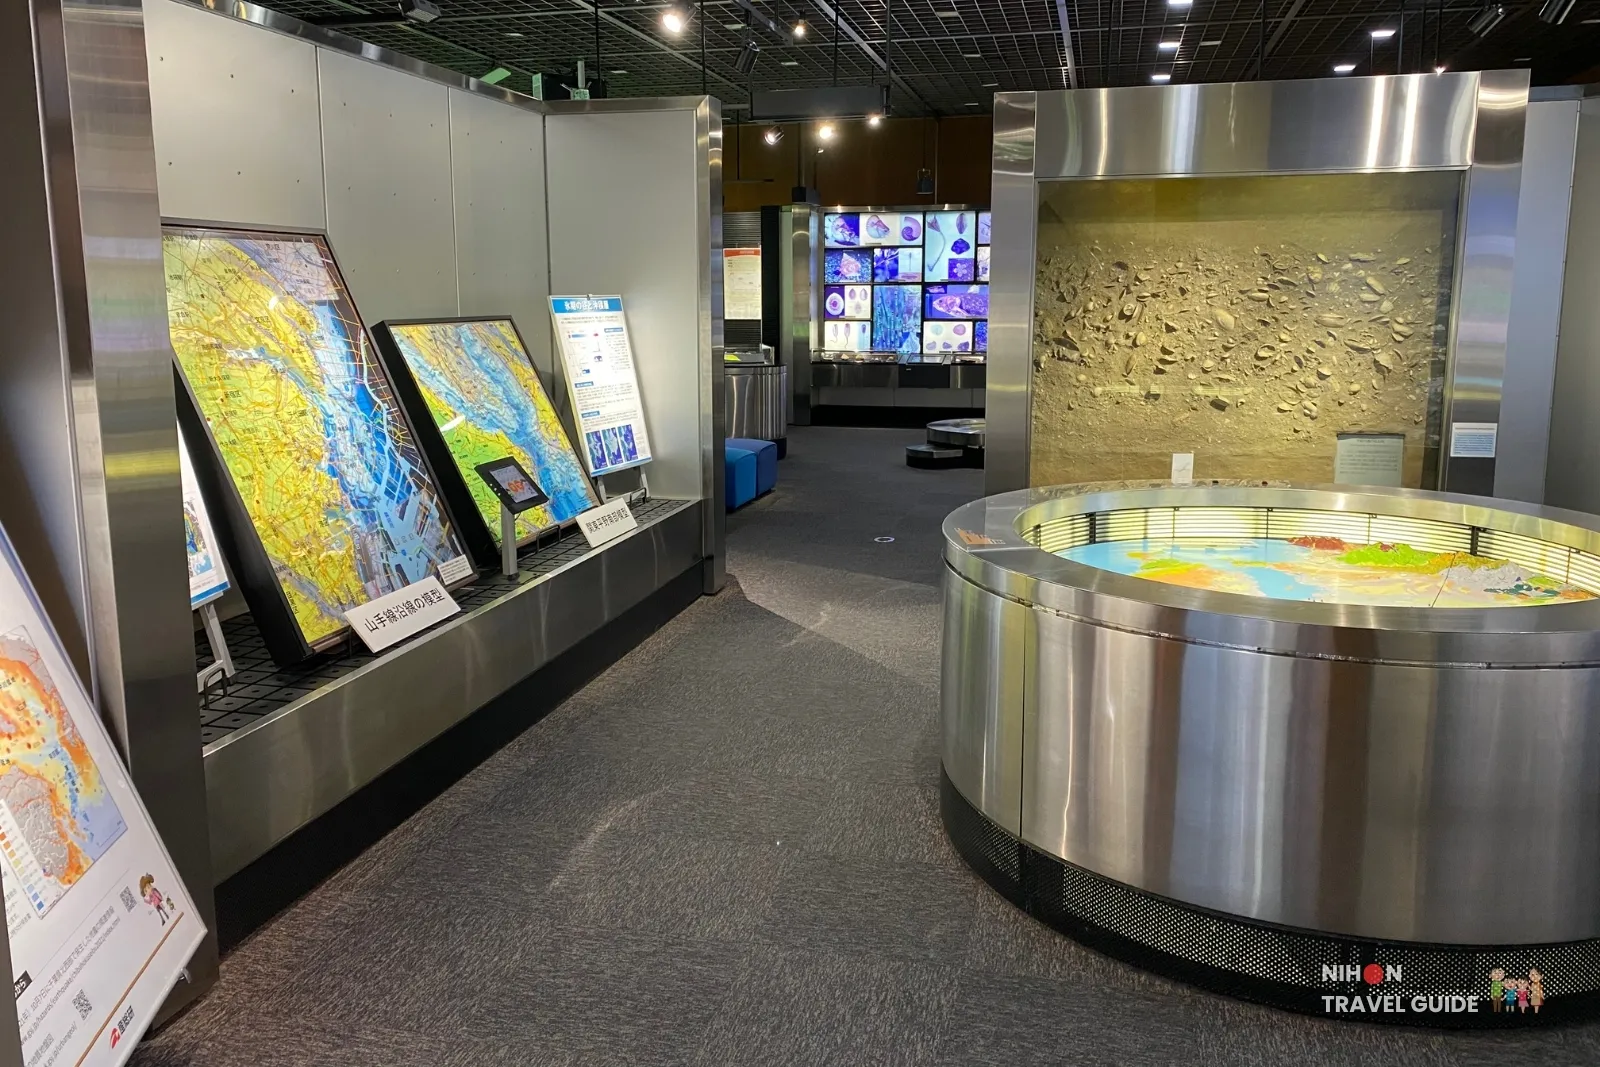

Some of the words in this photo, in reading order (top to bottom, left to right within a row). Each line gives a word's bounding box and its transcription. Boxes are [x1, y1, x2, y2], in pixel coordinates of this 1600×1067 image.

[364, 587, 445, 633] 山手線沿線の模型
